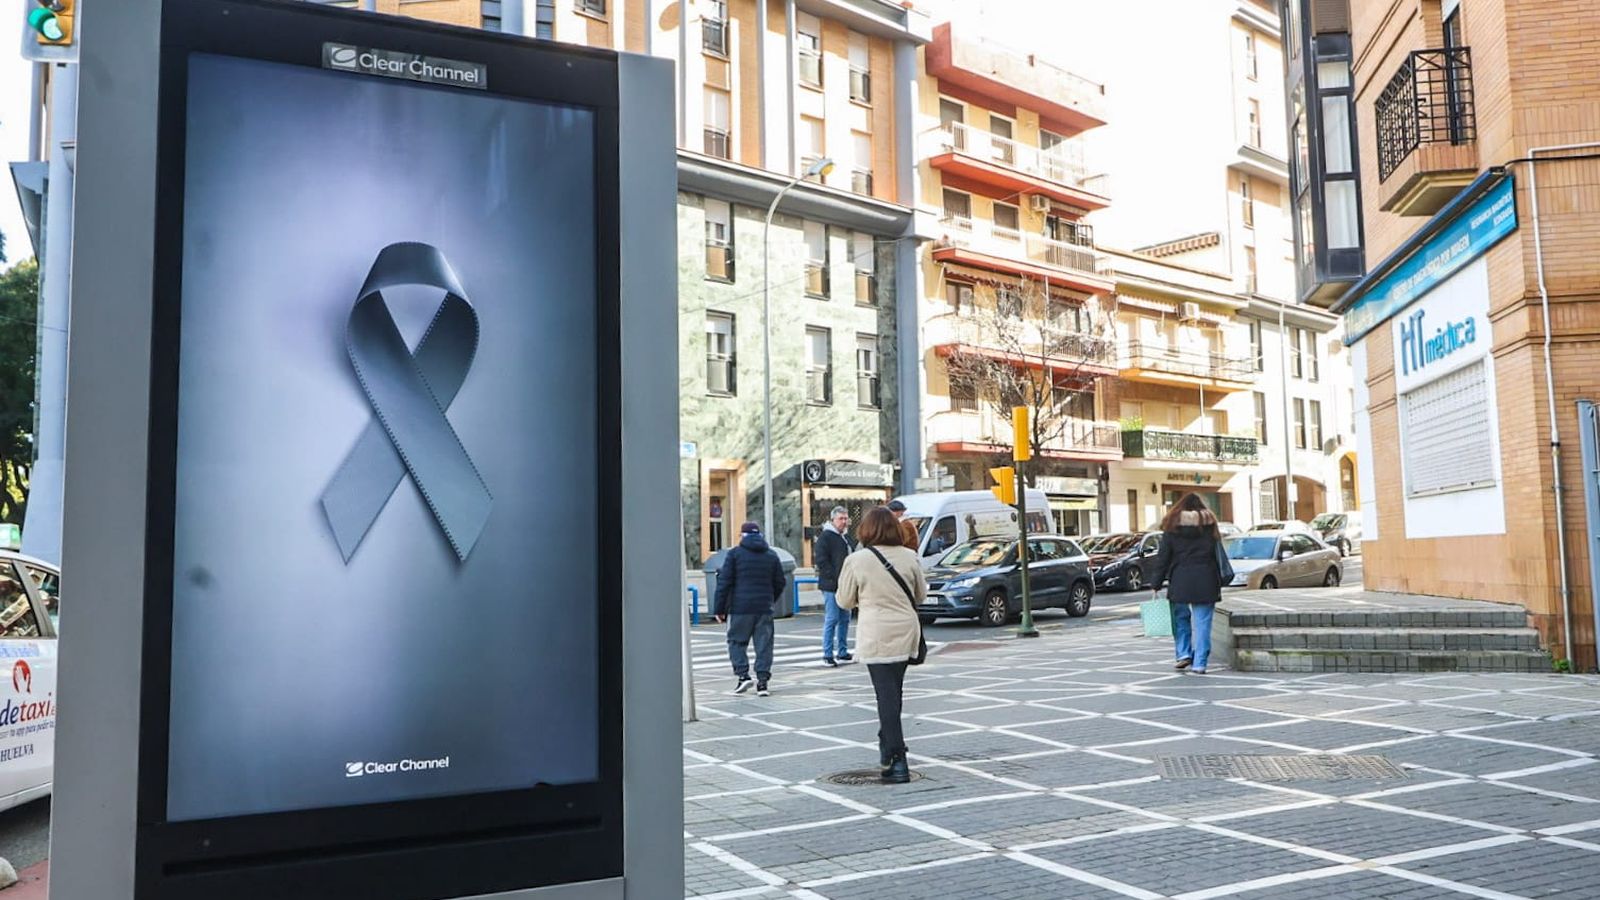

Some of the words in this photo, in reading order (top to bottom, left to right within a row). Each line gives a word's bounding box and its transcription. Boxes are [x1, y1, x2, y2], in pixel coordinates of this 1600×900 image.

[359, 53, 406, 73] Clear
[409, 60, 479, 83] Channel
[1400, 309, 1425, 376] HT
[0, 743, 34, 762] HUELVA
[364, 762, 398, 774] Clear
[399, 756, 449, 771] Channel
